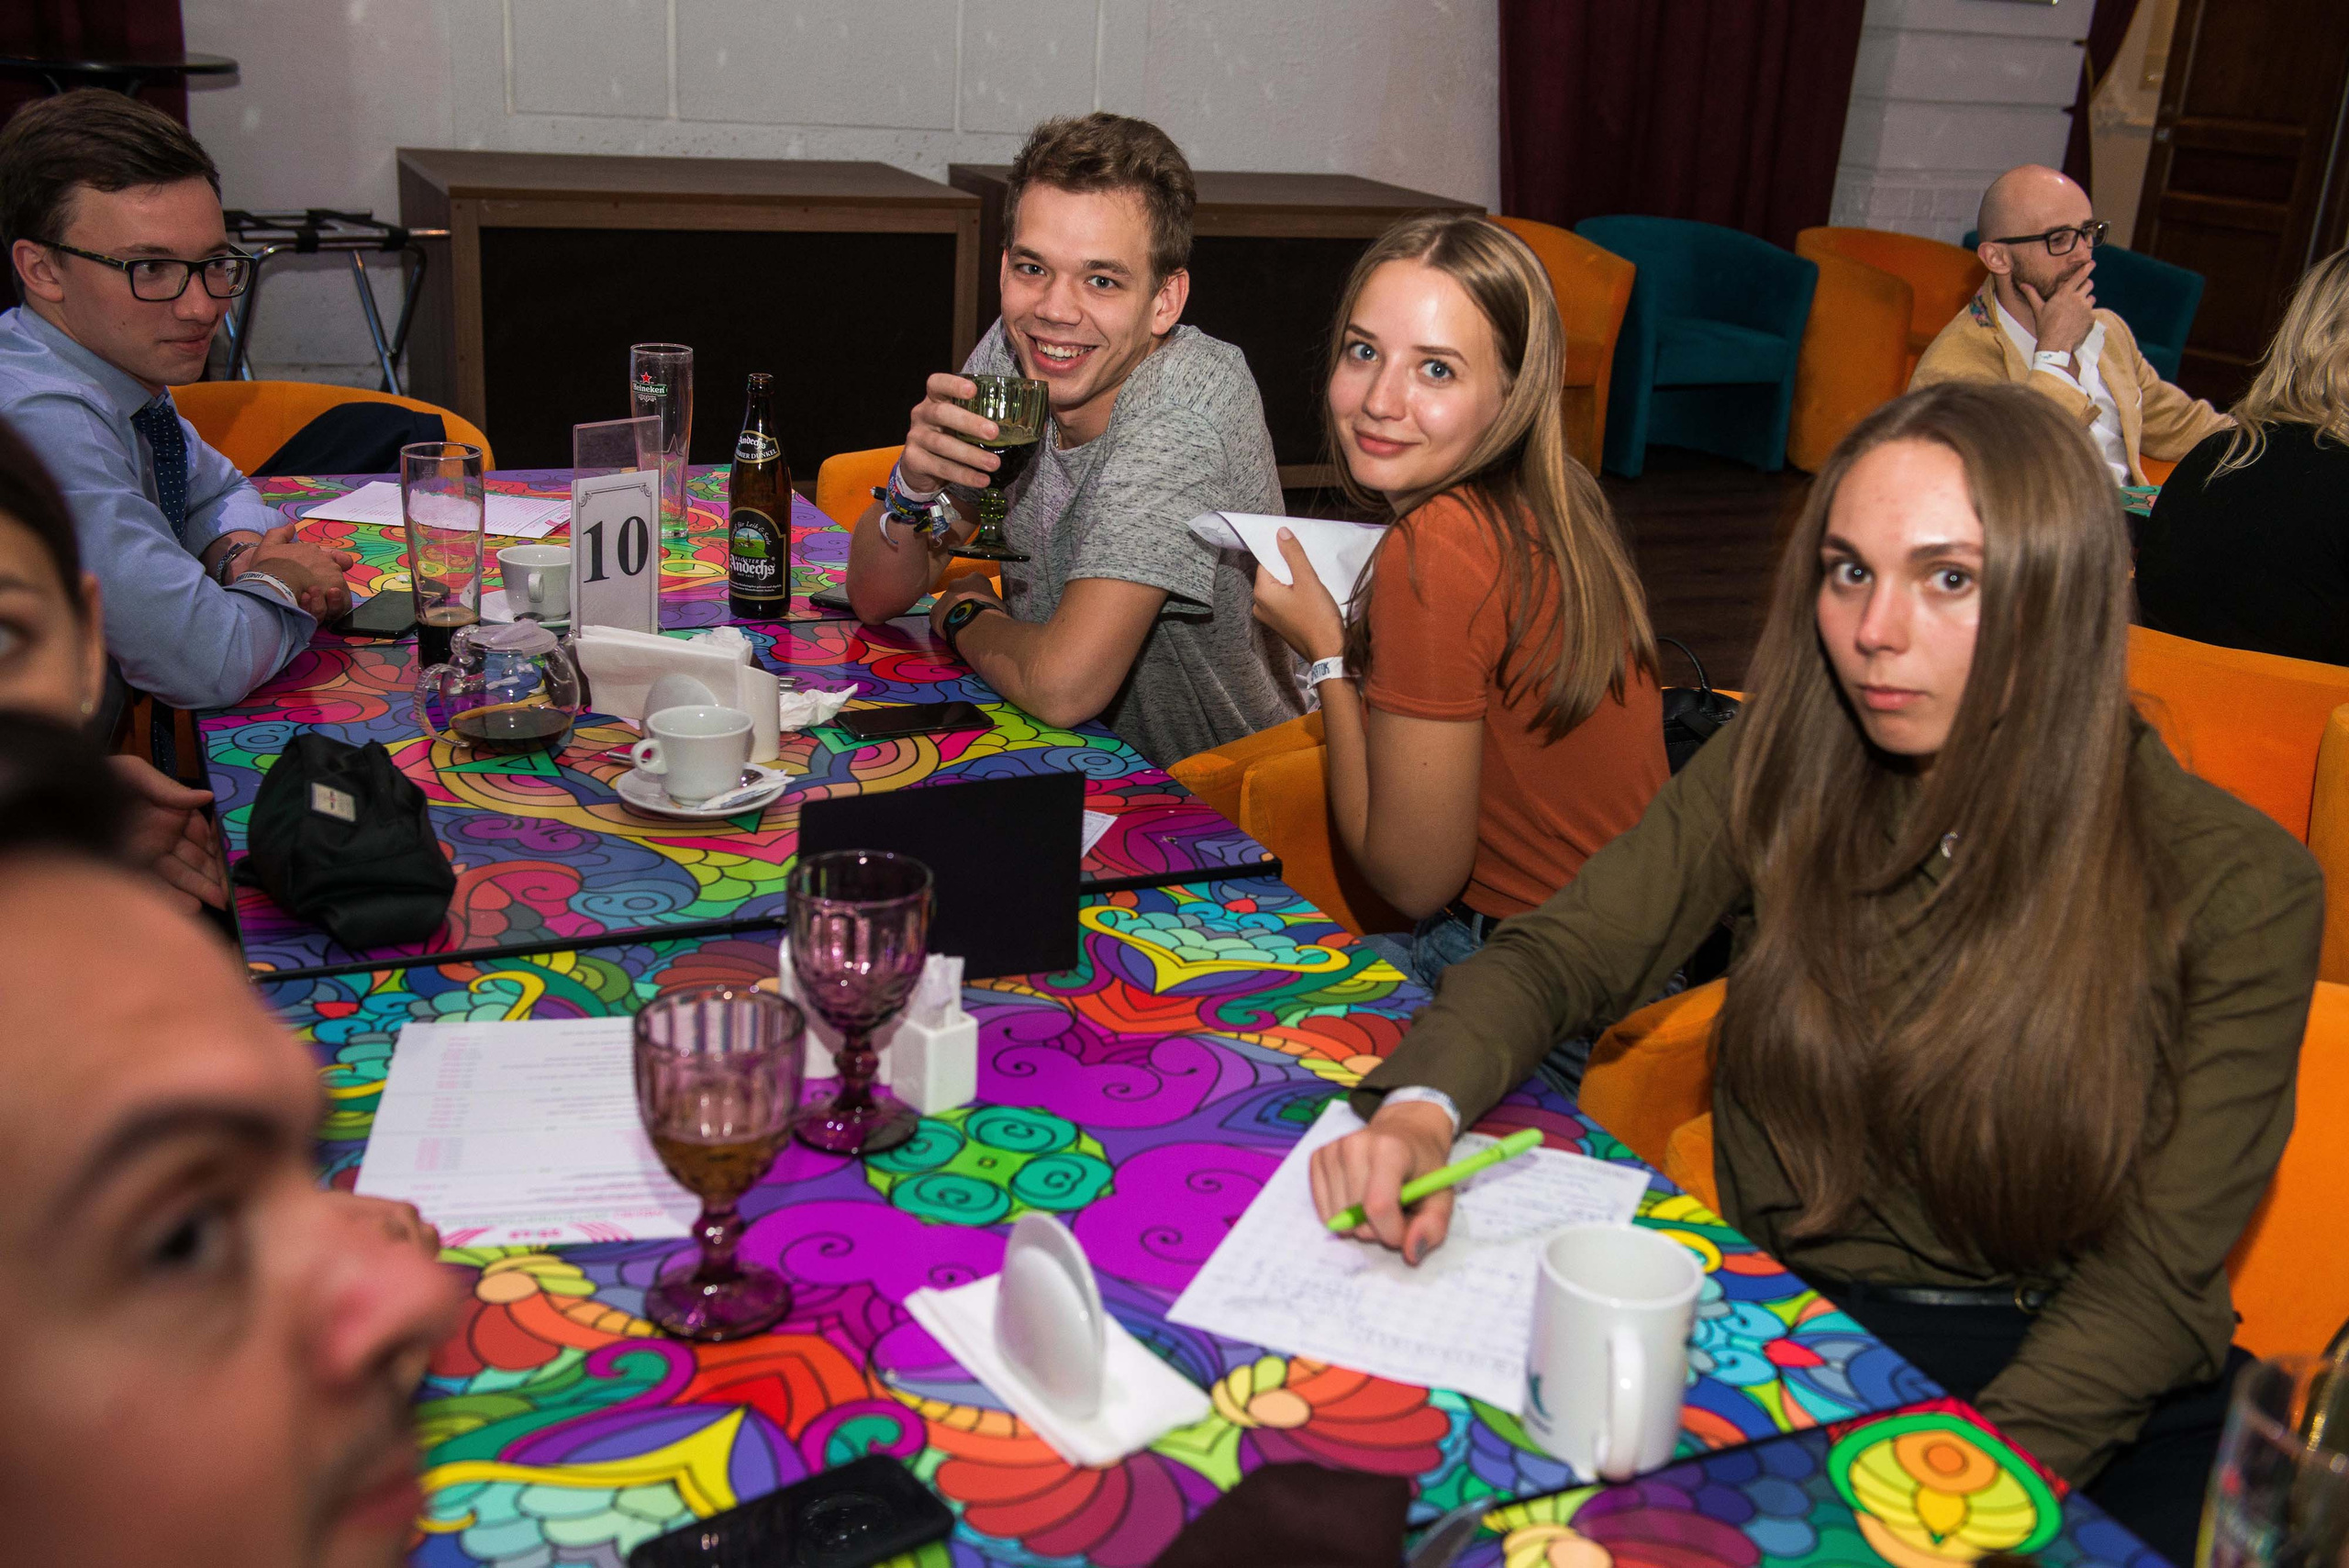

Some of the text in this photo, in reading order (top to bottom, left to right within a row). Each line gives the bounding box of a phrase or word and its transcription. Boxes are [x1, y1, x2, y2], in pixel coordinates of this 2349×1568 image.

[633, 384, 664, 394] Heineken
[751, 450, 778, 460] DUNKEL
[583, 516, 649, 584] 10
[729, 553, 776, 580] Andechs
